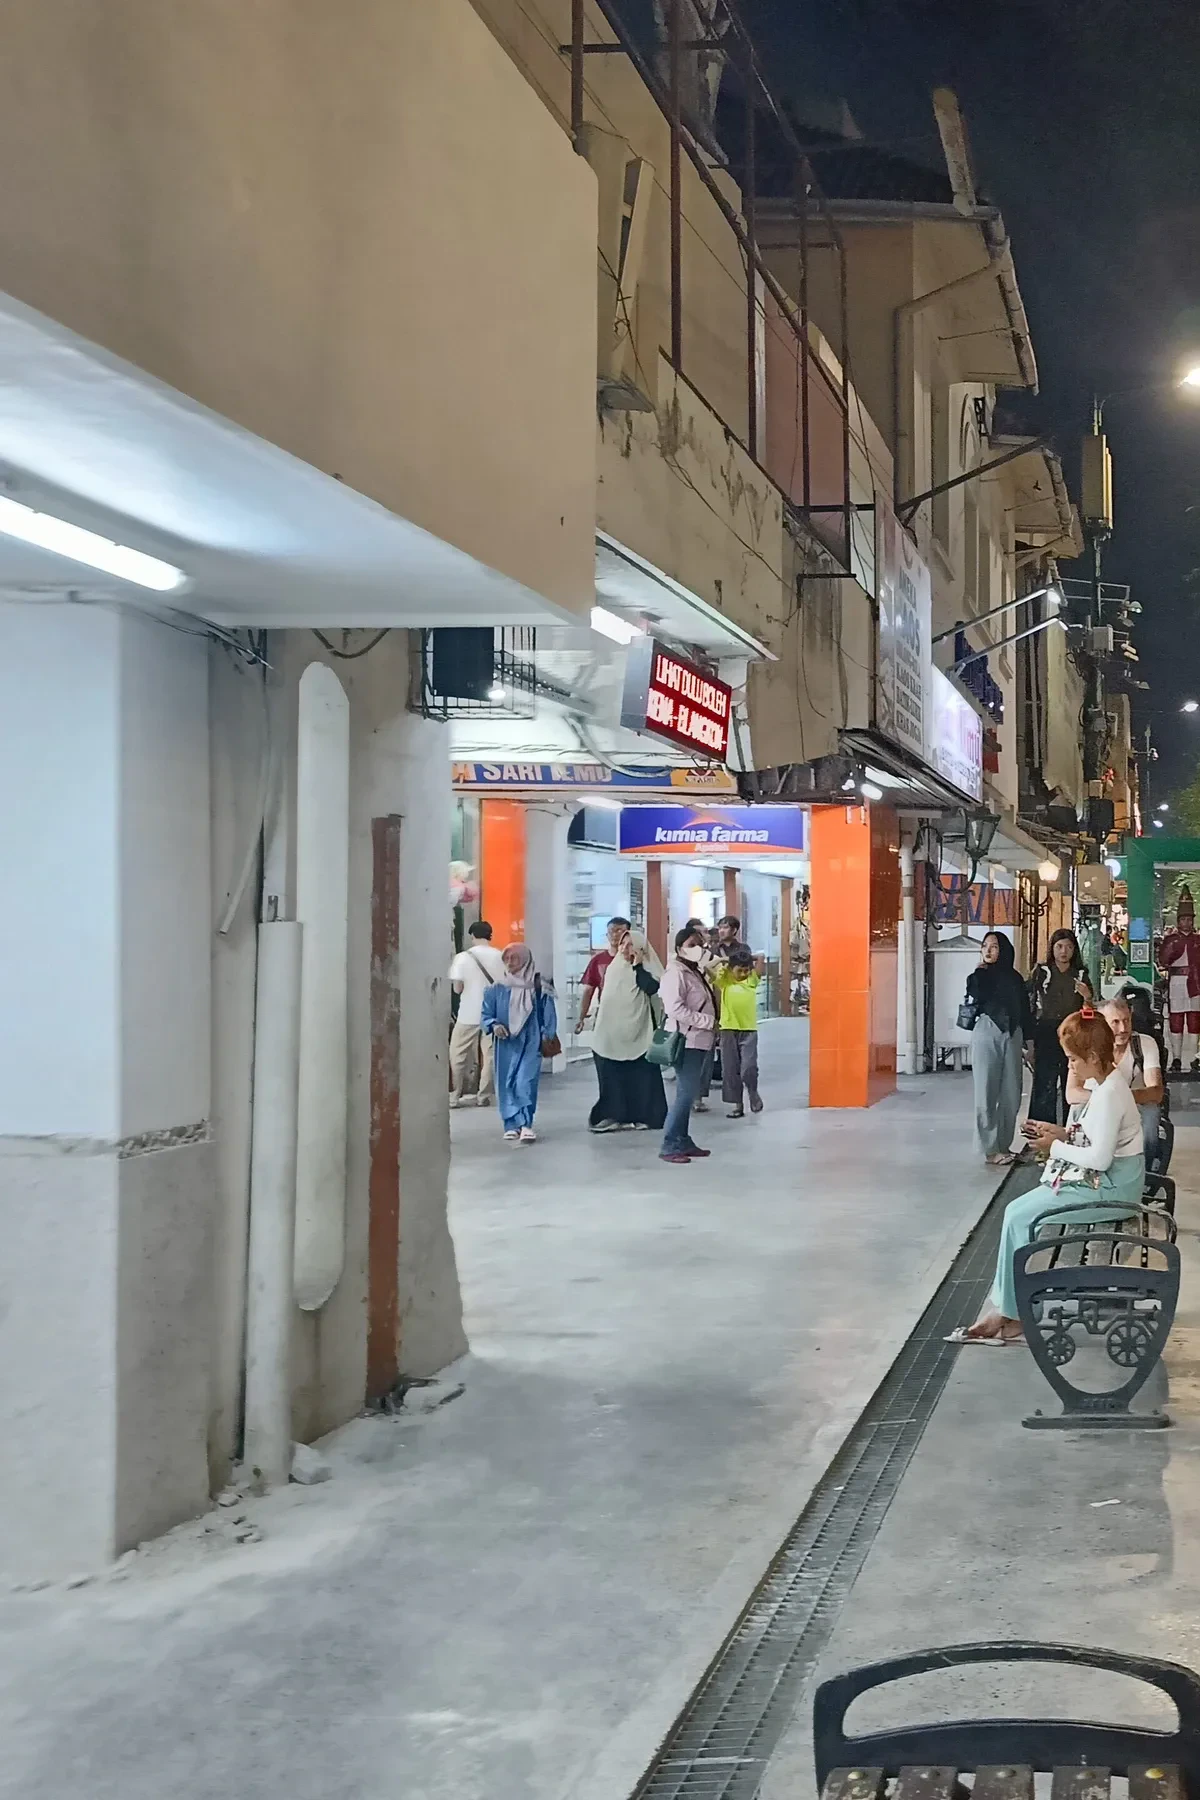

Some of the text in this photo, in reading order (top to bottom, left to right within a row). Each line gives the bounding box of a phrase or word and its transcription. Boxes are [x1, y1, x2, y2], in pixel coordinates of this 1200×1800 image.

[483, 763, 543, 781] SARI
[655, 826, 769, 842] kimia farma
